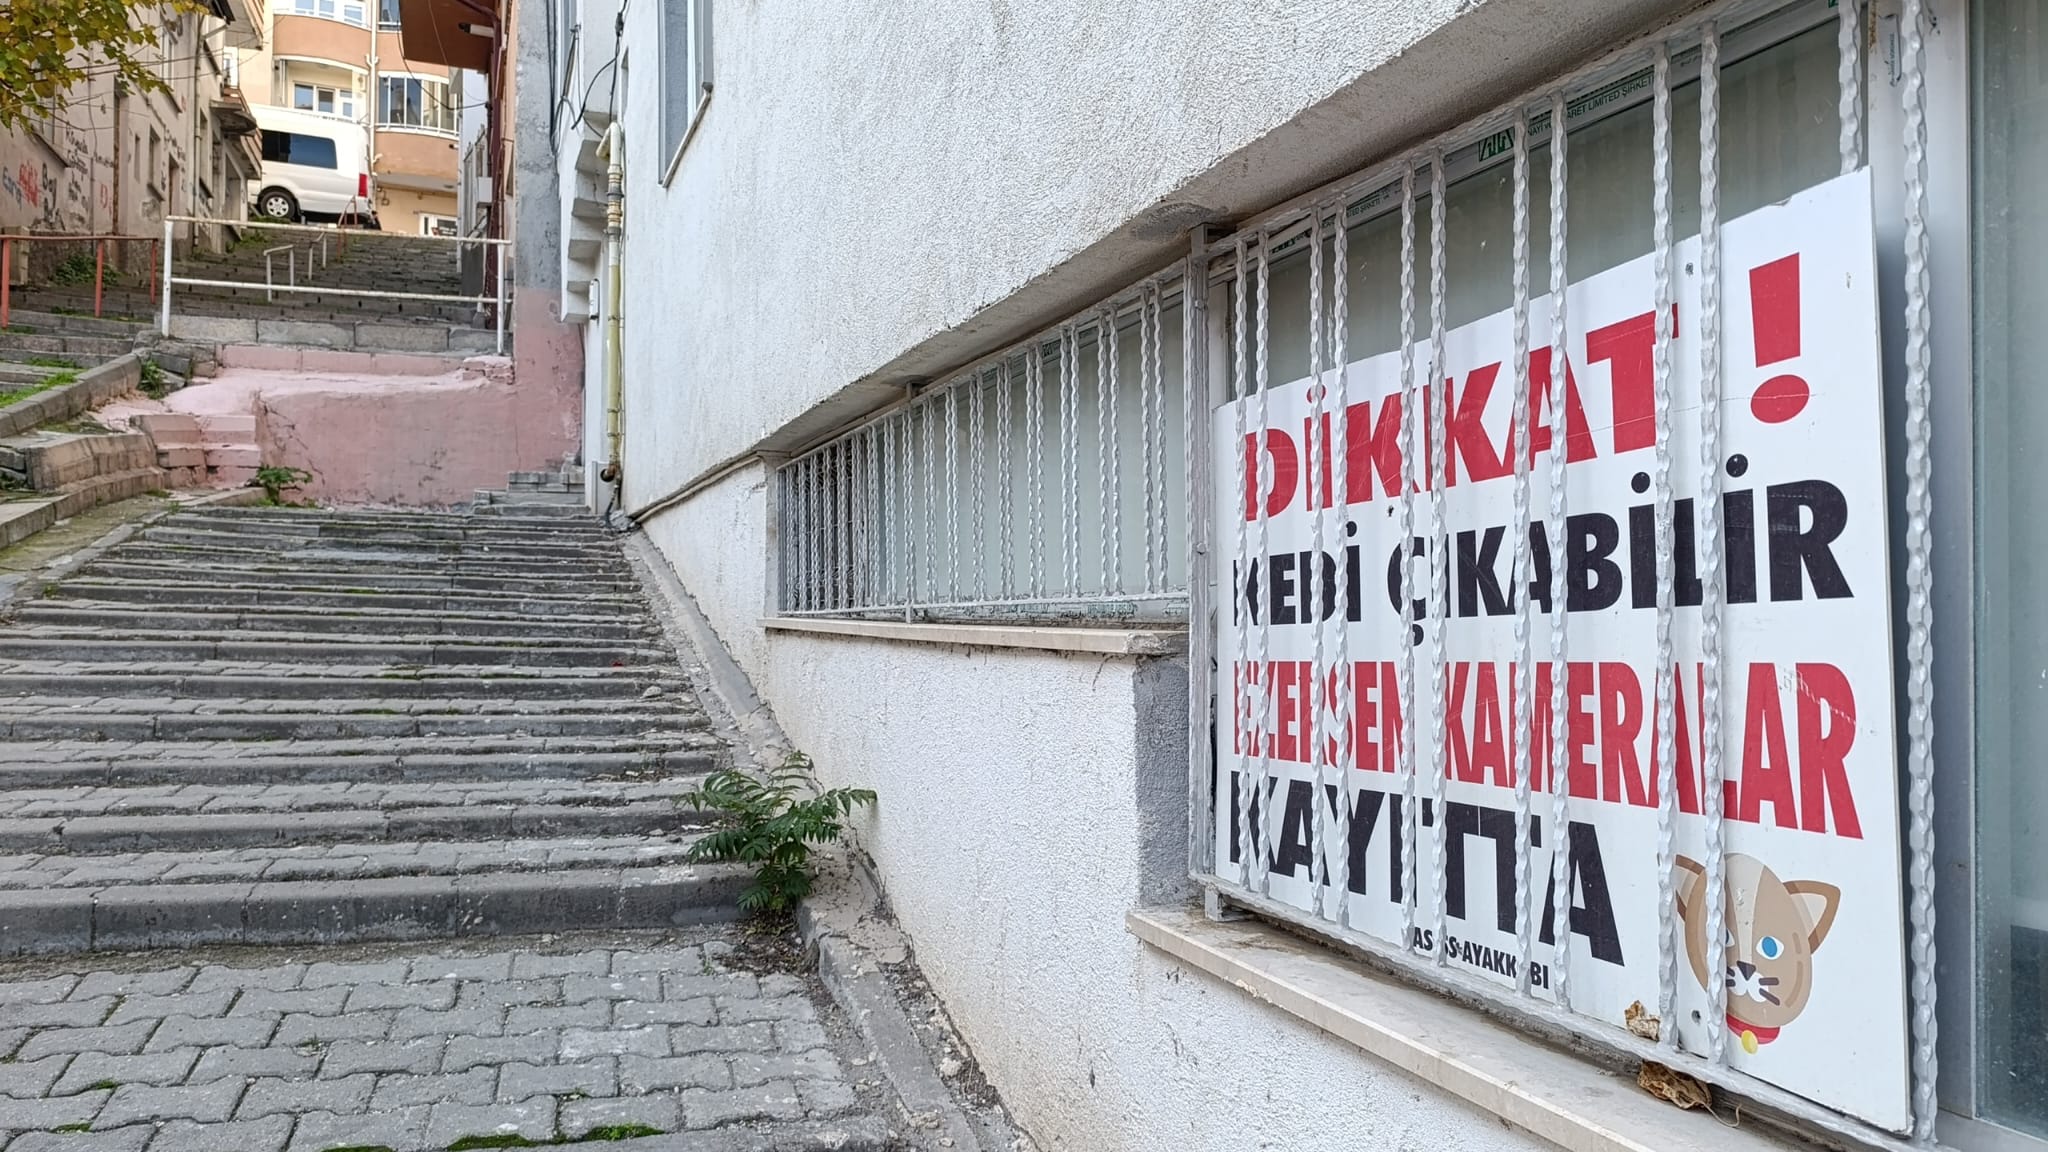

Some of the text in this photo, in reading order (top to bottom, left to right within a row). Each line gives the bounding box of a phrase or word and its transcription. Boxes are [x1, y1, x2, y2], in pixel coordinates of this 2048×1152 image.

[1233, 520, 1362, 628] KEDİ
[1229, 770, 1625, 968] KAYITTA
[1462, 940, 1549, 990] AYAKKBI
